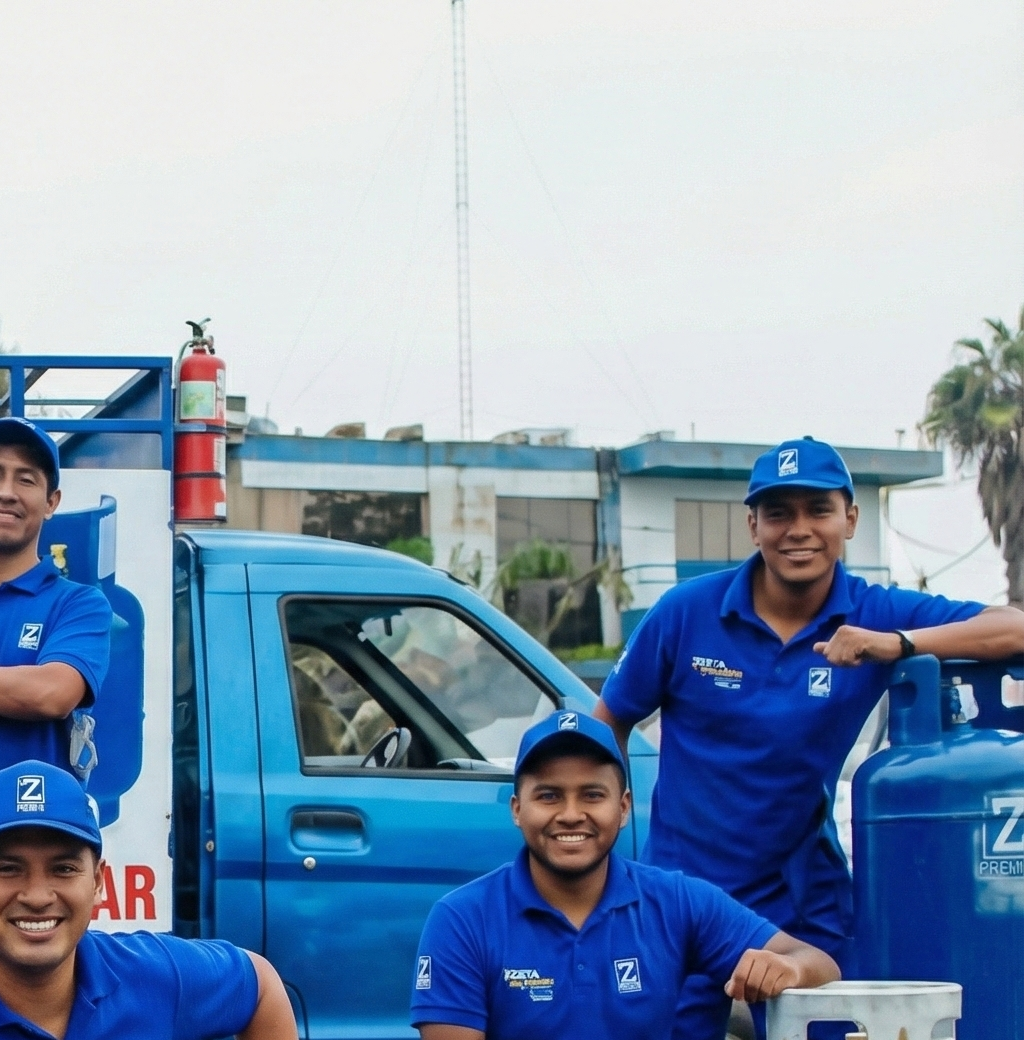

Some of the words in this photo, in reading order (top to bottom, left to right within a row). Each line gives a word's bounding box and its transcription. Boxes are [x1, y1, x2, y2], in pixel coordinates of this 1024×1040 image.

[780, 452, 796, 468] Z
[21, 626, 40, 640] Z
[811, 671, 828, 690] Z
[561, 713, 576, 727] Z
[20, 779, 42, 800] Z
[419, 959, 429, 978] Z
[618, 962, 637, 982] Z
